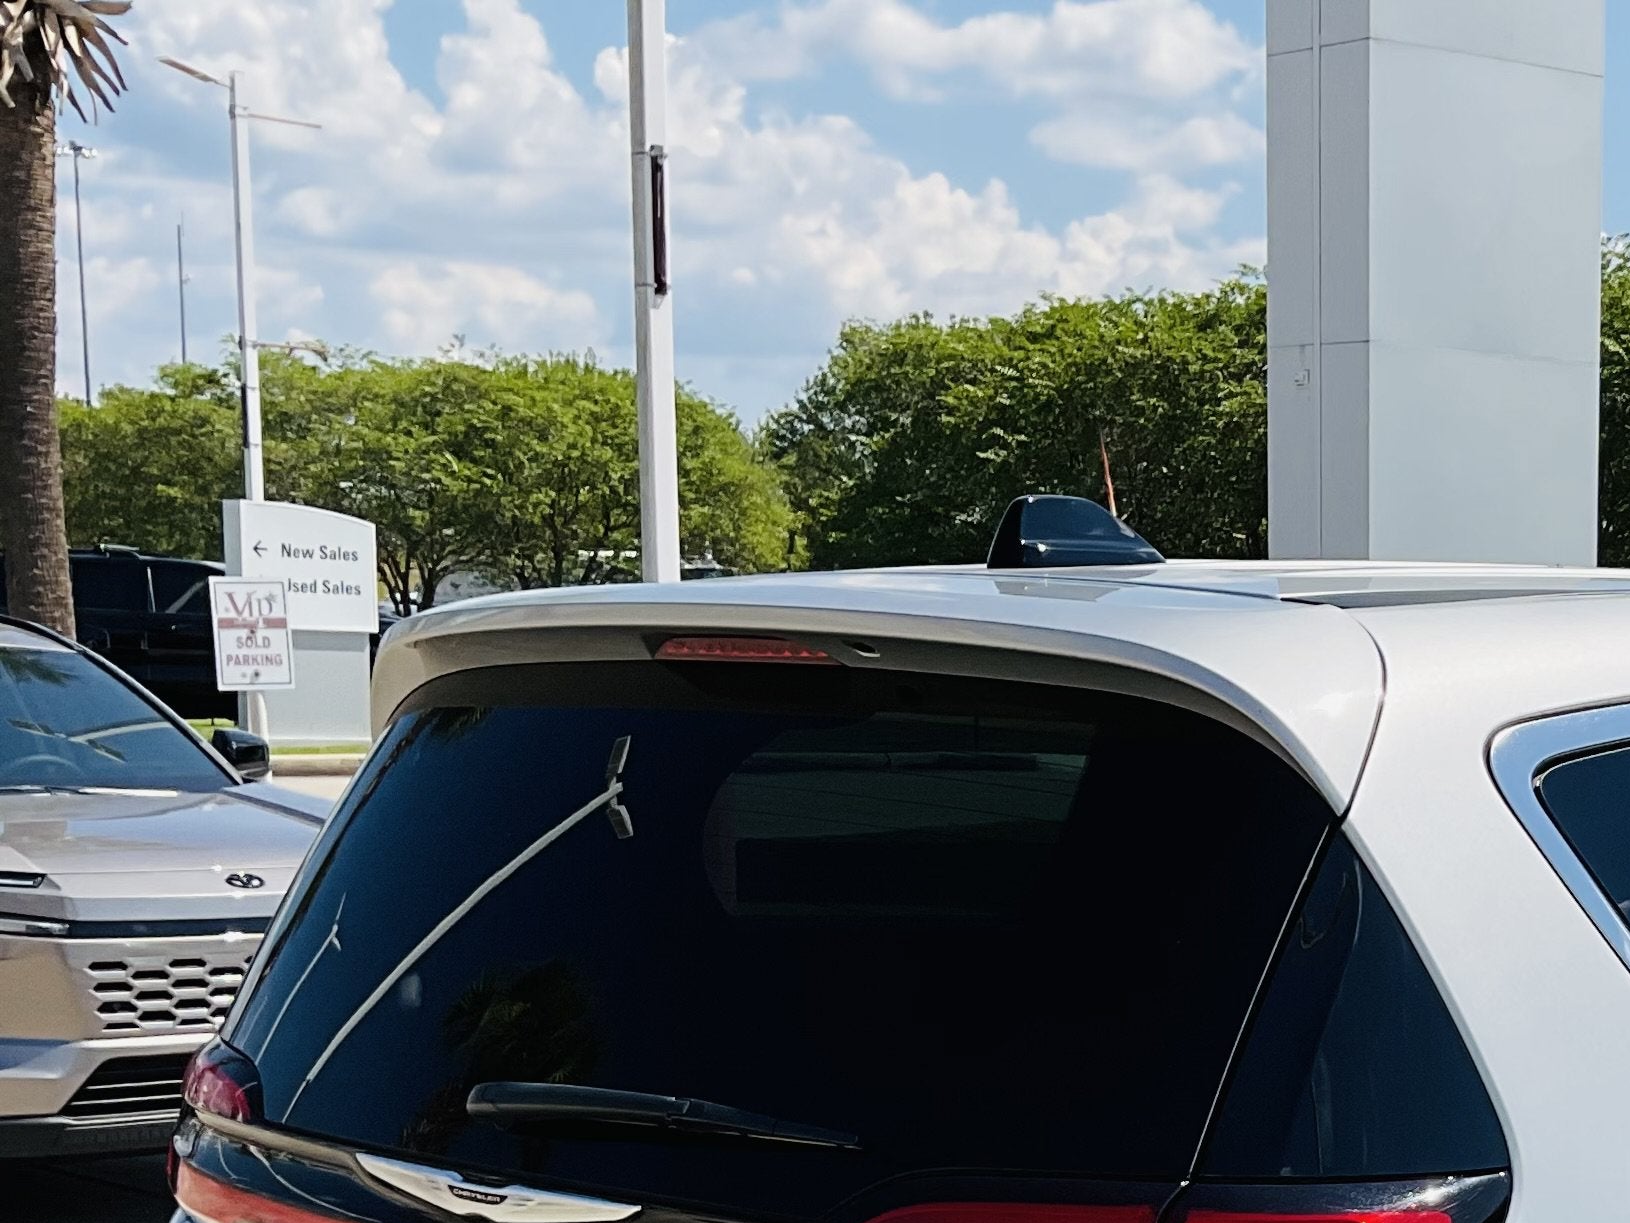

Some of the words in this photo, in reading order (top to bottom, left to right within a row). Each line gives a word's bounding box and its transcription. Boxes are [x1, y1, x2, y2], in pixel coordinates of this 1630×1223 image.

[281, 543, 314, 559] New
[320, 545, 358, 561] Sales
[322, 580, 361, 595] Sales
[236, 635, 271, 649] SOLD
[226, 653, 283, 667] PARKING
